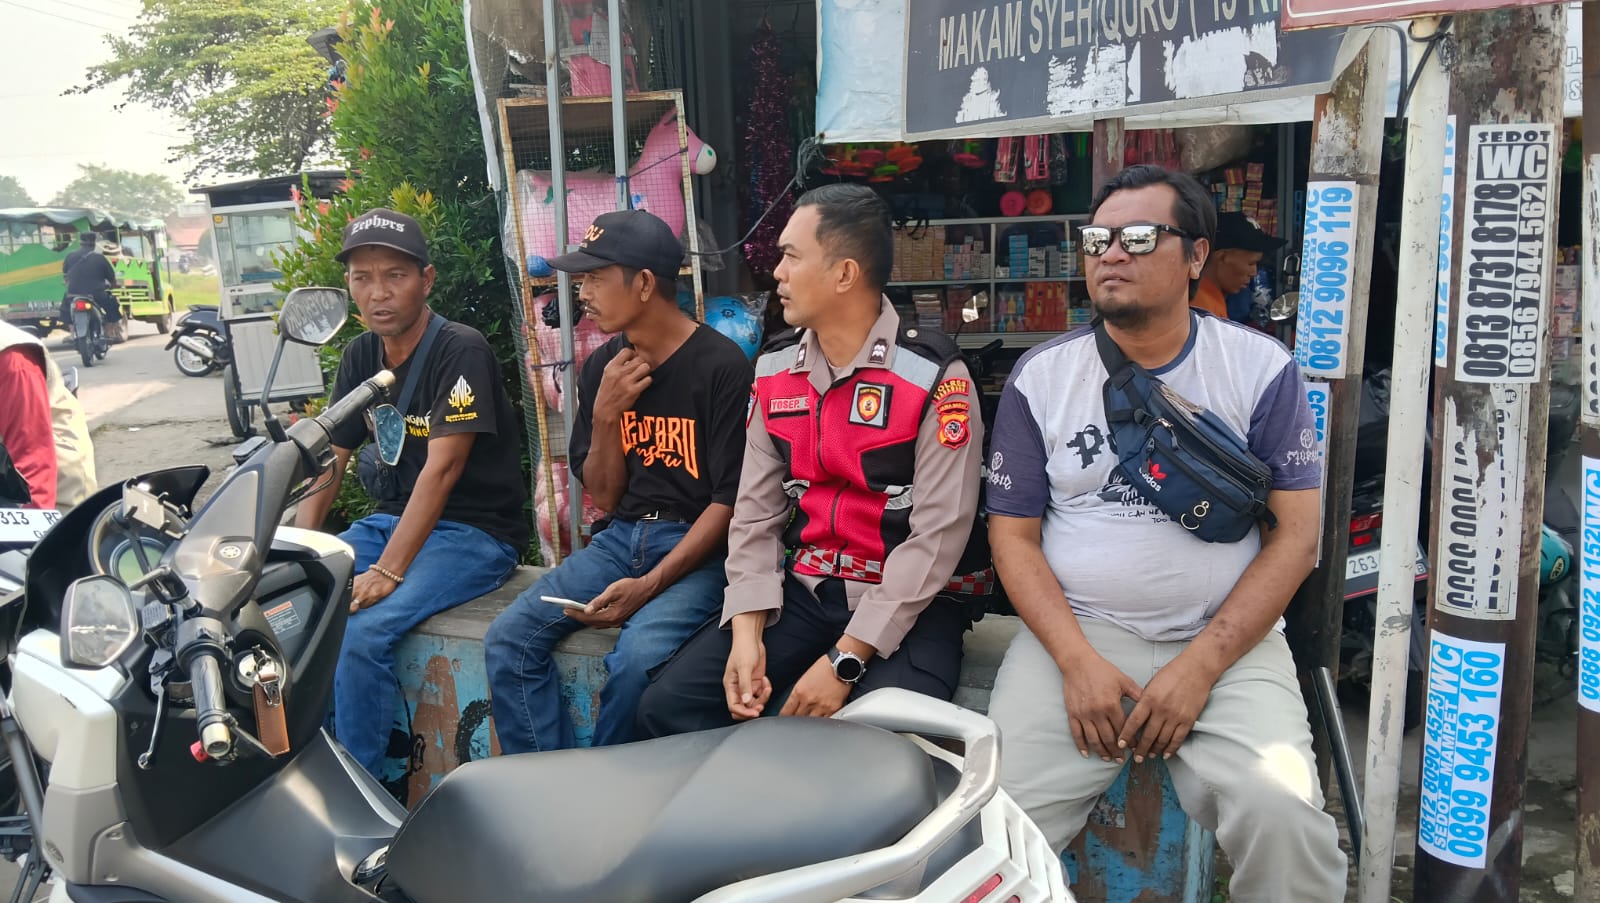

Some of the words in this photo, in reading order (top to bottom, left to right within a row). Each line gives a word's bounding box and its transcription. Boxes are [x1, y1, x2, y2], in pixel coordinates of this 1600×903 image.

[938, 0, 1023, 72] MAKAM
[1029, 0, 1092, 54] SYEH
[1478, 130, 1551, 143] SEDOT
[1481, 145, 1548, 179] WC
[1318, 186, 1353, 233] 119
[1470, 182, 1521, 244] 8178
[1519, 185, 1547, 236] 562
[1314, 240, 1349, 303] 9096
[1466, 248, 1517, 309] 8731
[1514, 239, 1544, 303] 7944
[1308, 309, 1343, 370] 0812
[1462, 313, 1511, 378] 0813
[1509, 306, 1540, 374] 0856
[1348, 555, 1378, 575] 263
[1582, 587, 1600, 642] 0922
[1431, 642, 1464, 697] WC
[1460, 650, 1501, 703] 160
[1581, 647, 1600, 701] 0888
[1426, 695, 1445, 742] 4523
[1438, 701, 1458, 777] MAMPET
[1422, 744, 1440, 792] 8090
[1454, 712, 1496, 783] 9453
[1420, 794, 1437, 844] 0812
[1434, 795, 1449, 850] SEDOT
[1447, 788, 1489, 858] 0899
